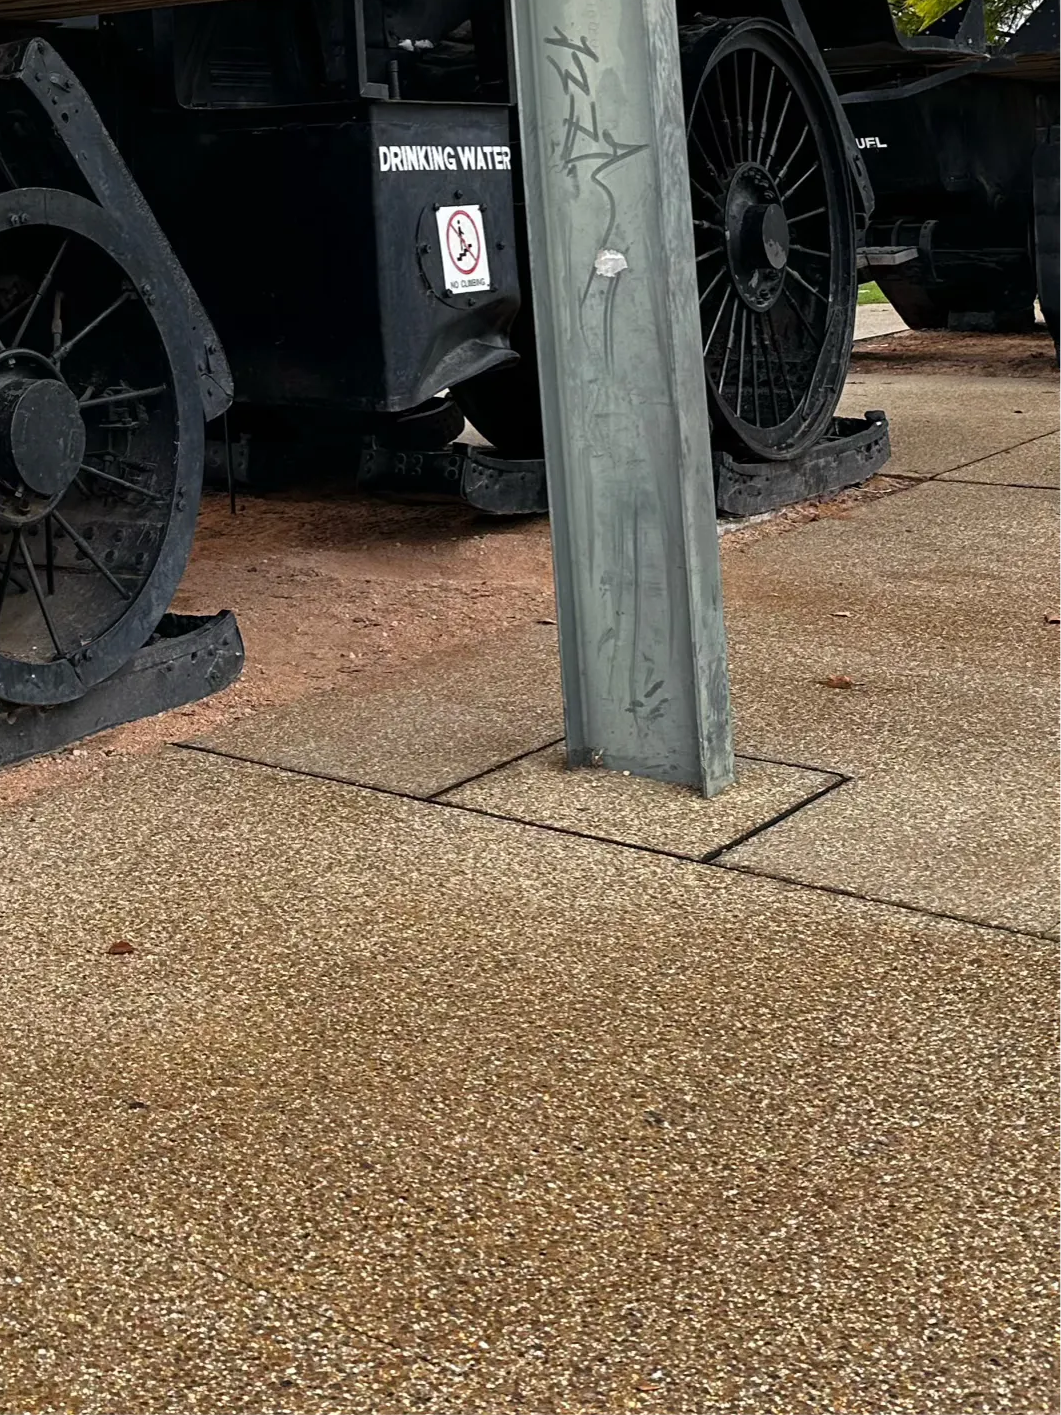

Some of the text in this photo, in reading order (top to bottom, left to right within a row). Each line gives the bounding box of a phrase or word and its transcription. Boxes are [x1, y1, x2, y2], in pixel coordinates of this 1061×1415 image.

[378, 145, 511, 172] DRINKING WATER
[450, 278, 486, 288] NO CLIMBING
